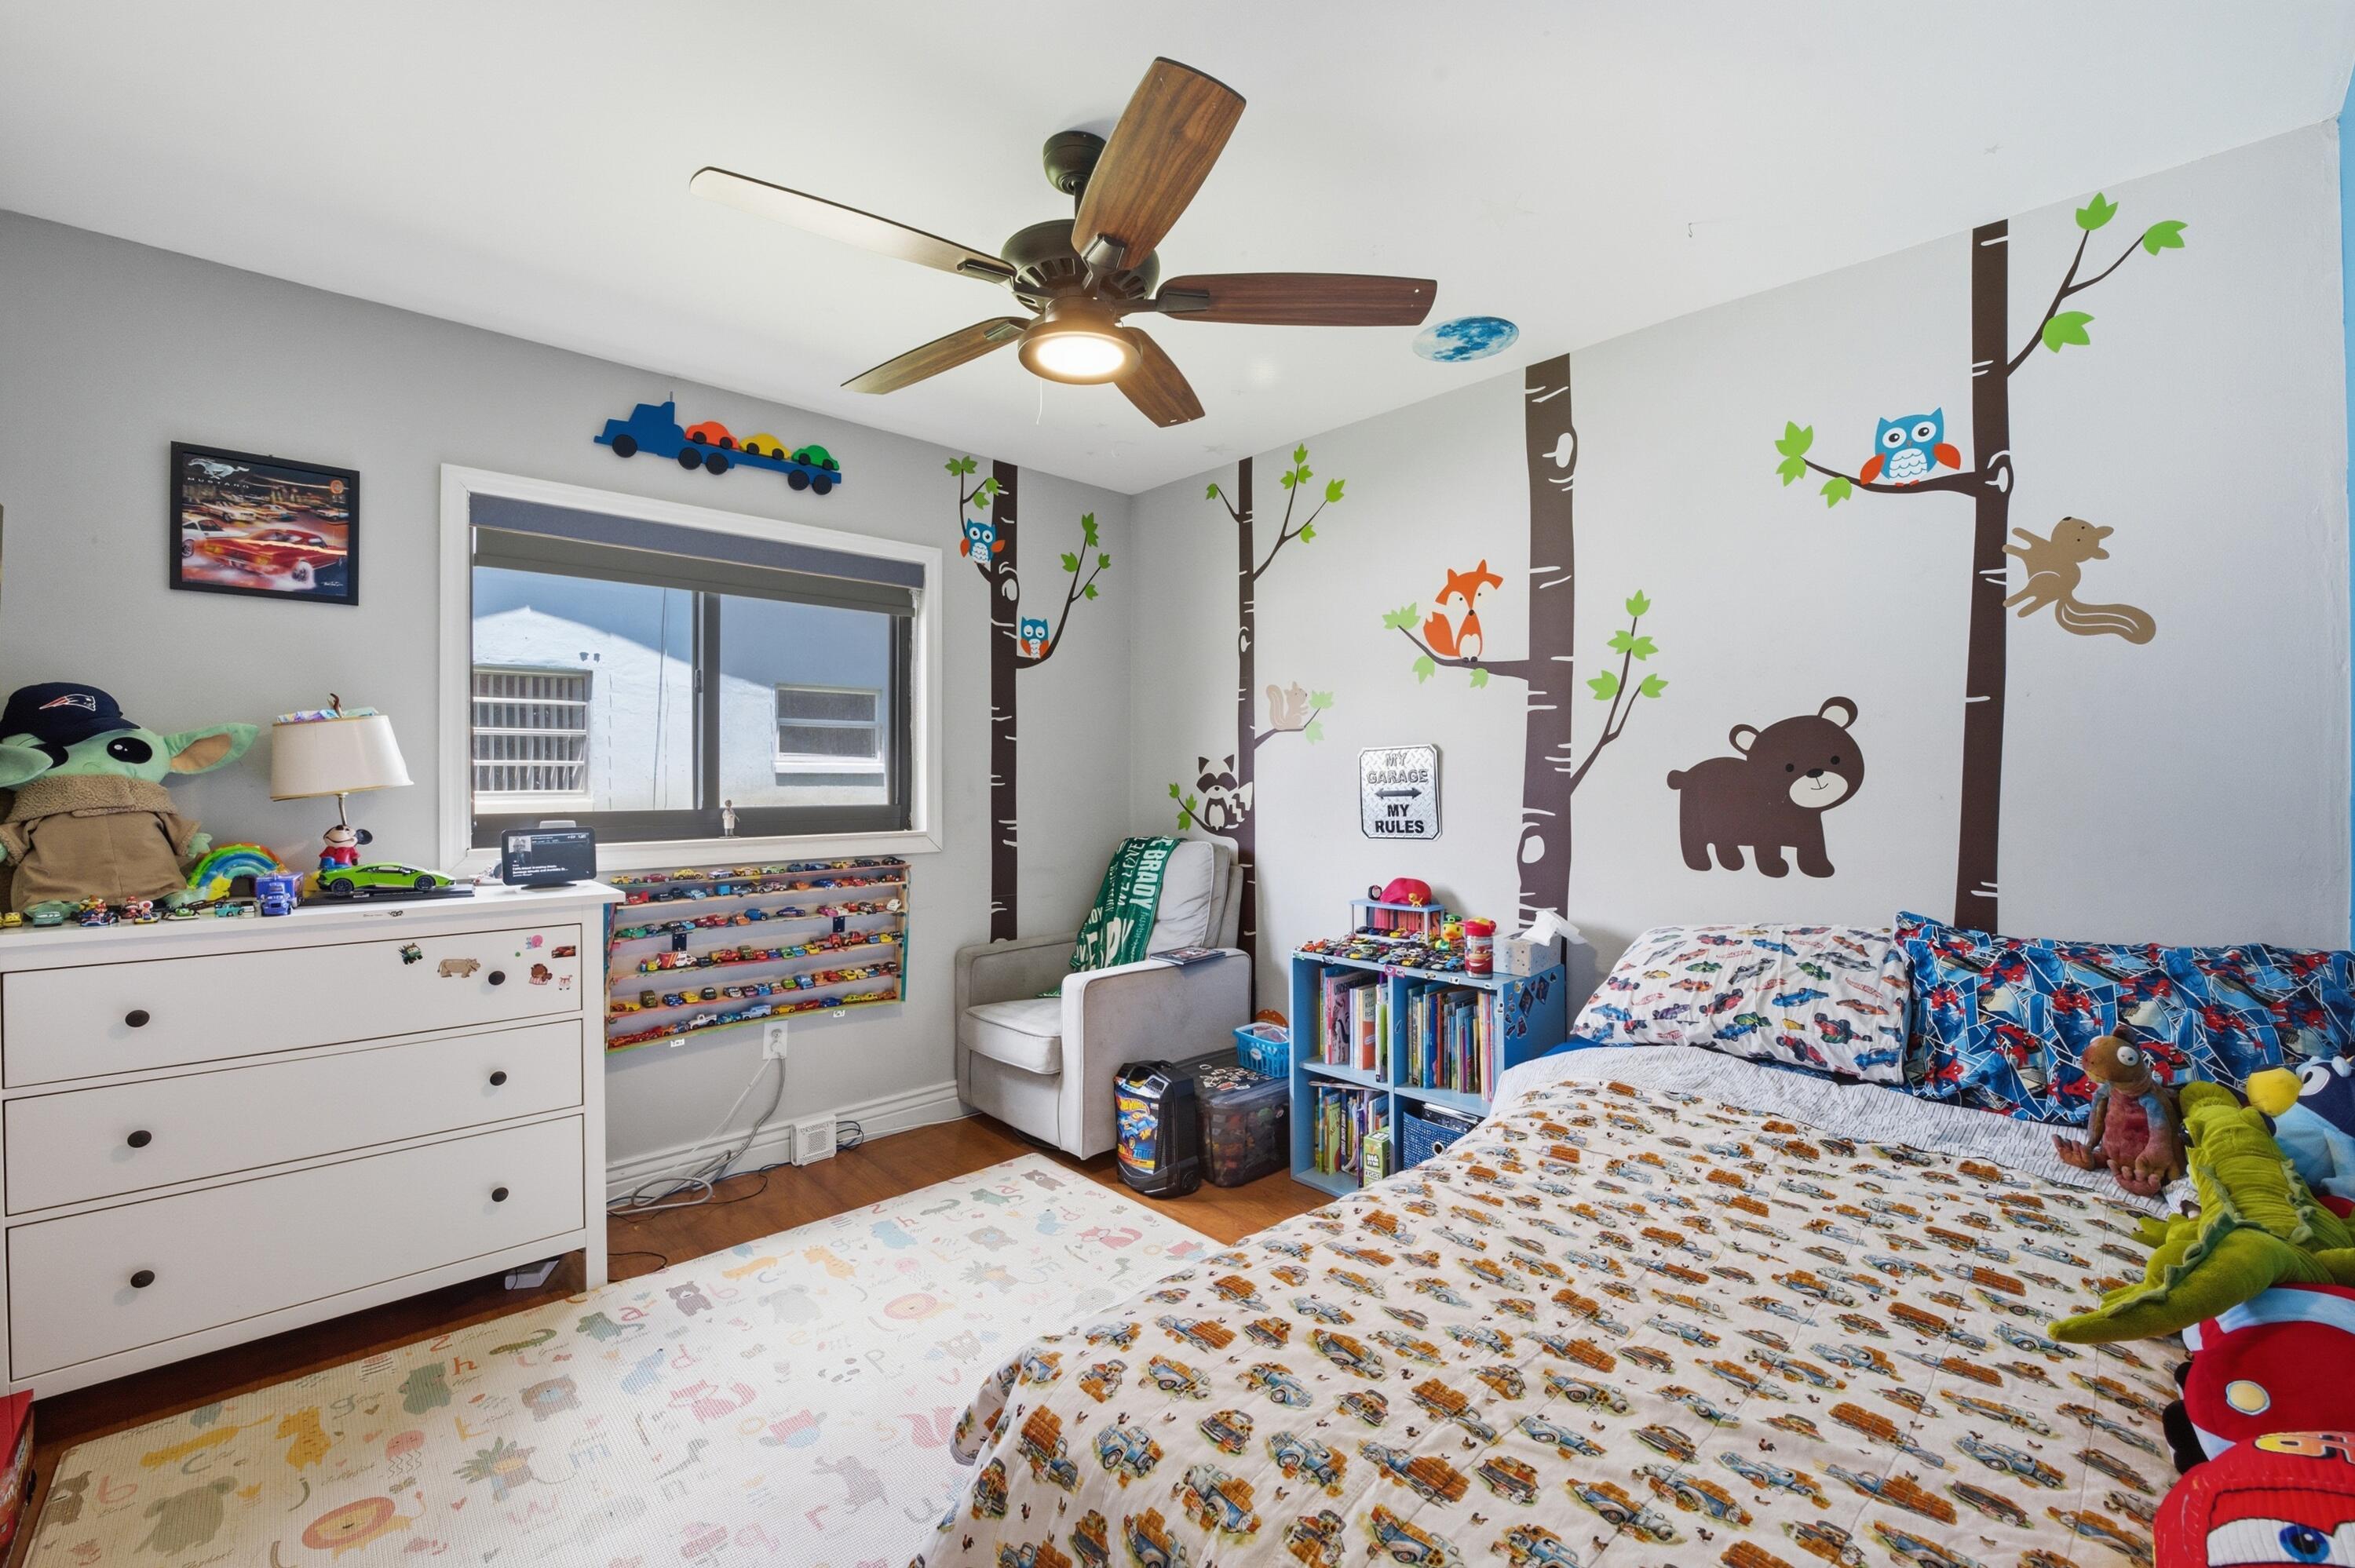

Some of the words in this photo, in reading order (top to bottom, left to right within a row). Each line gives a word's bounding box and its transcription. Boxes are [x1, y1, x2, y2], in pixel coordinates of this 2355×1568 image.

[1385, 753, 1407, 766] MY
[1367, 769, 1429, 784] GARAGE
[1387, 804, 1409, 817] MY
[1375, 820, 1425, 833] RULES
[1129, 849, 1167, 911] BRADY
